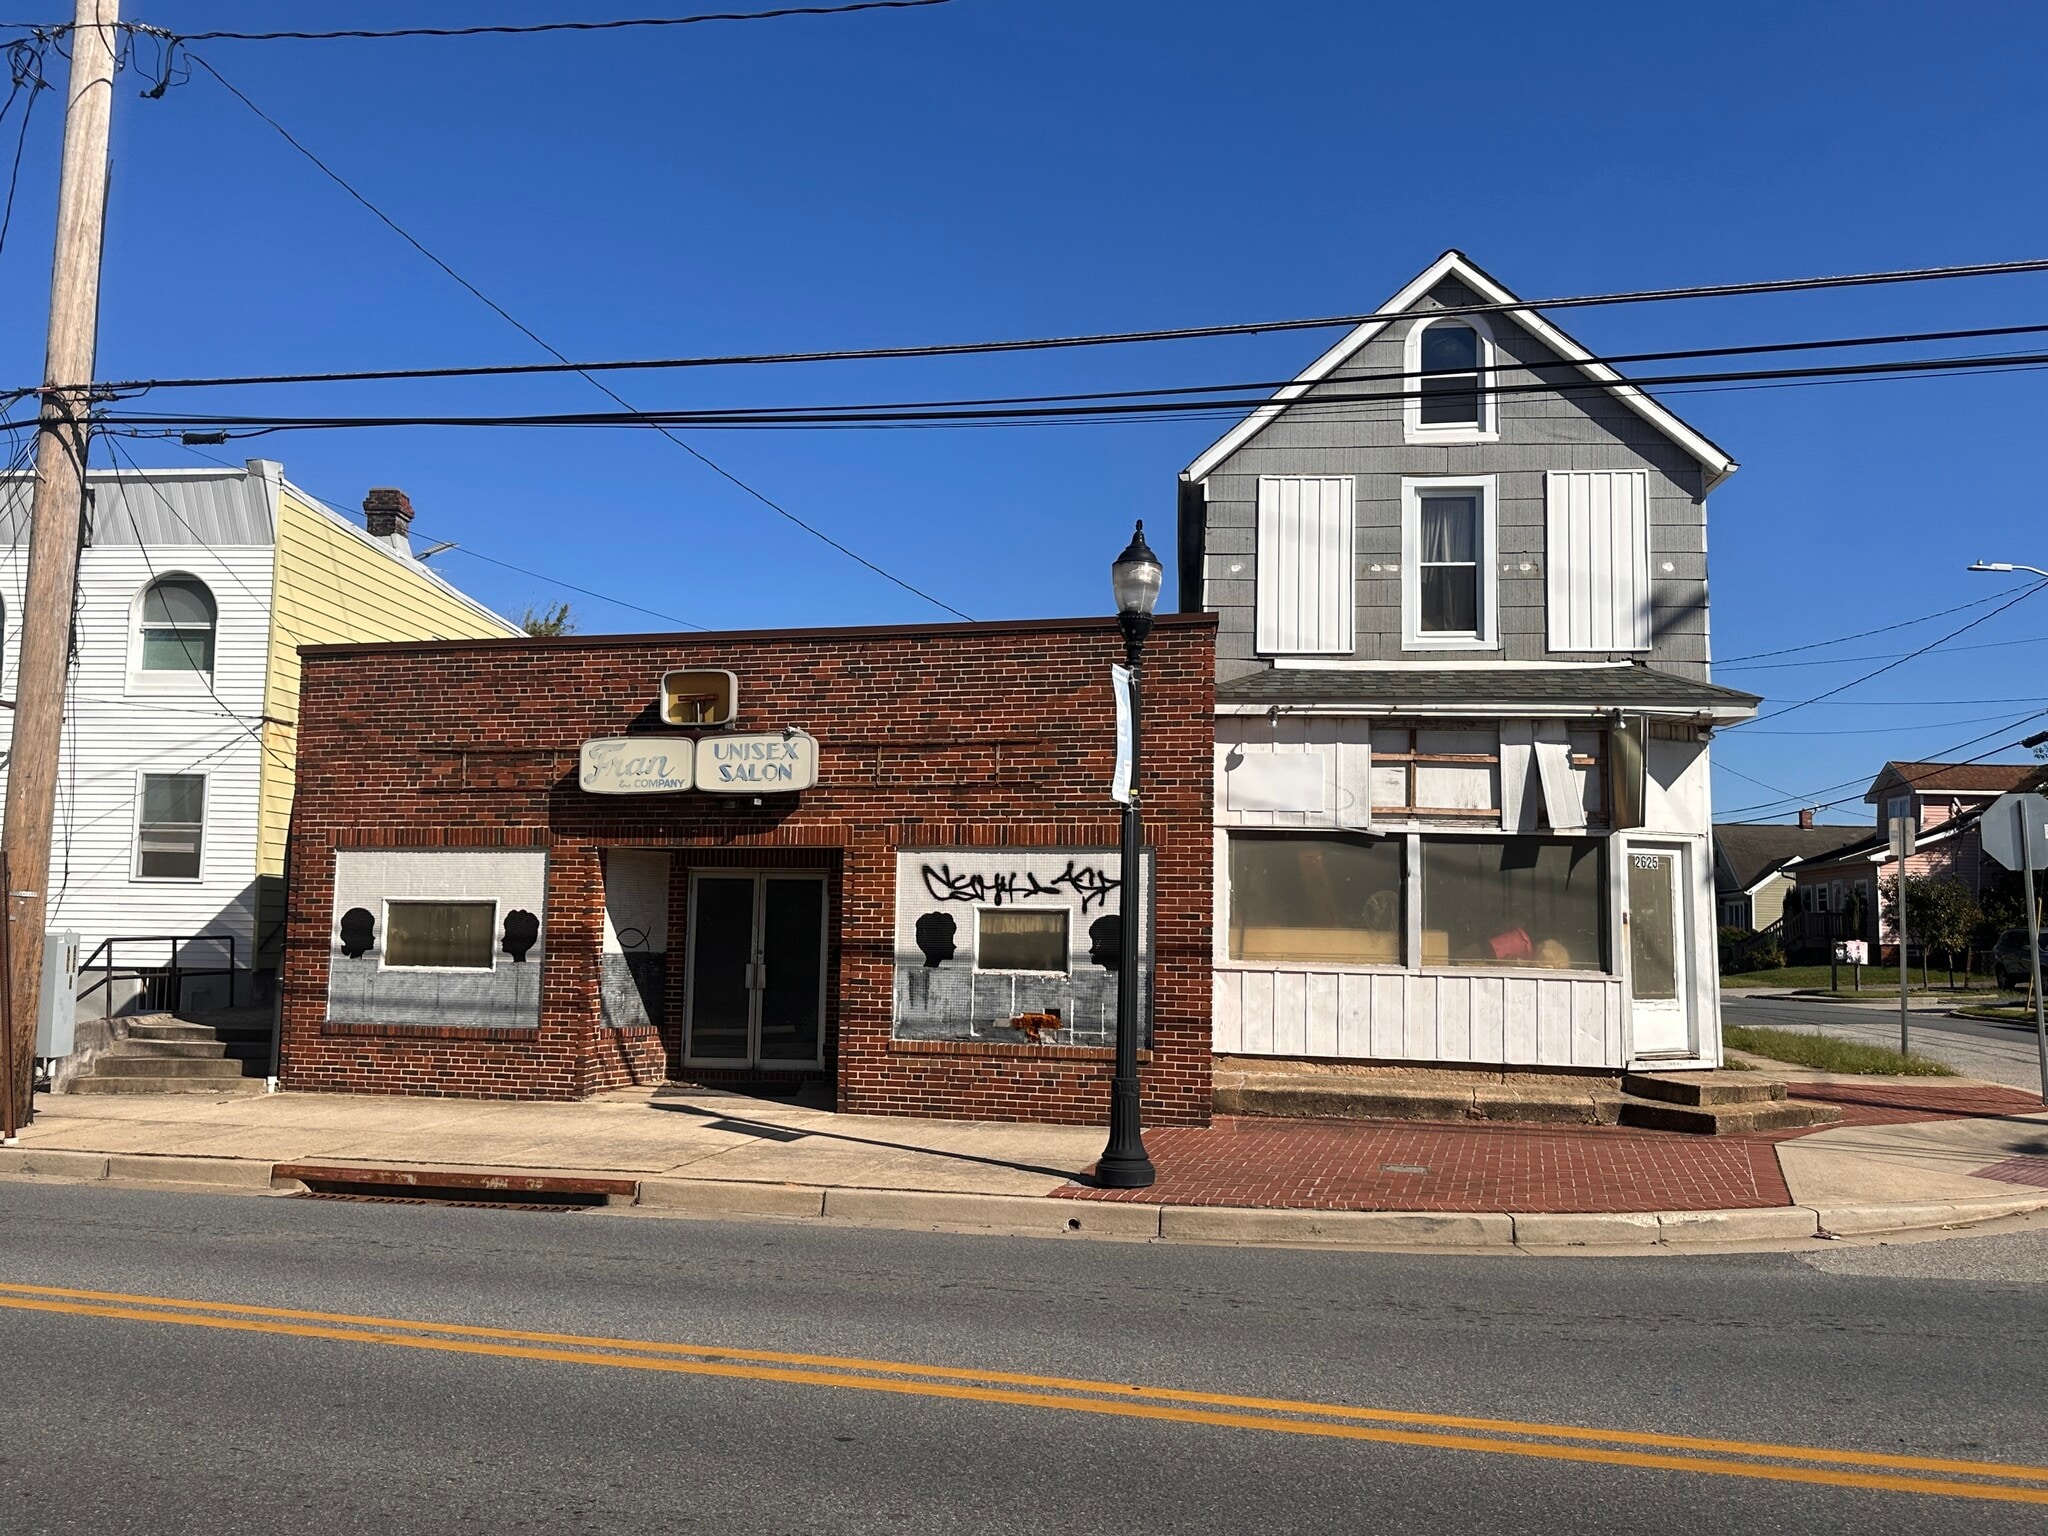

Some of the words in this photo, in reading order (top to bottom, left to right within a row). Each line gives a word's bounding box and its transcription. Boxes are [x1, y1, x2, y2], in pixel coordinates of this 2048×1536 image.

[714, 742, 799, 760] UNISEX
[584, 742, 675, 785] Fran
[718, 763, 793, 782] SALON
[634, 779, 685, 788] COMPANY
[1635, 856, 1658, 869] 2625
